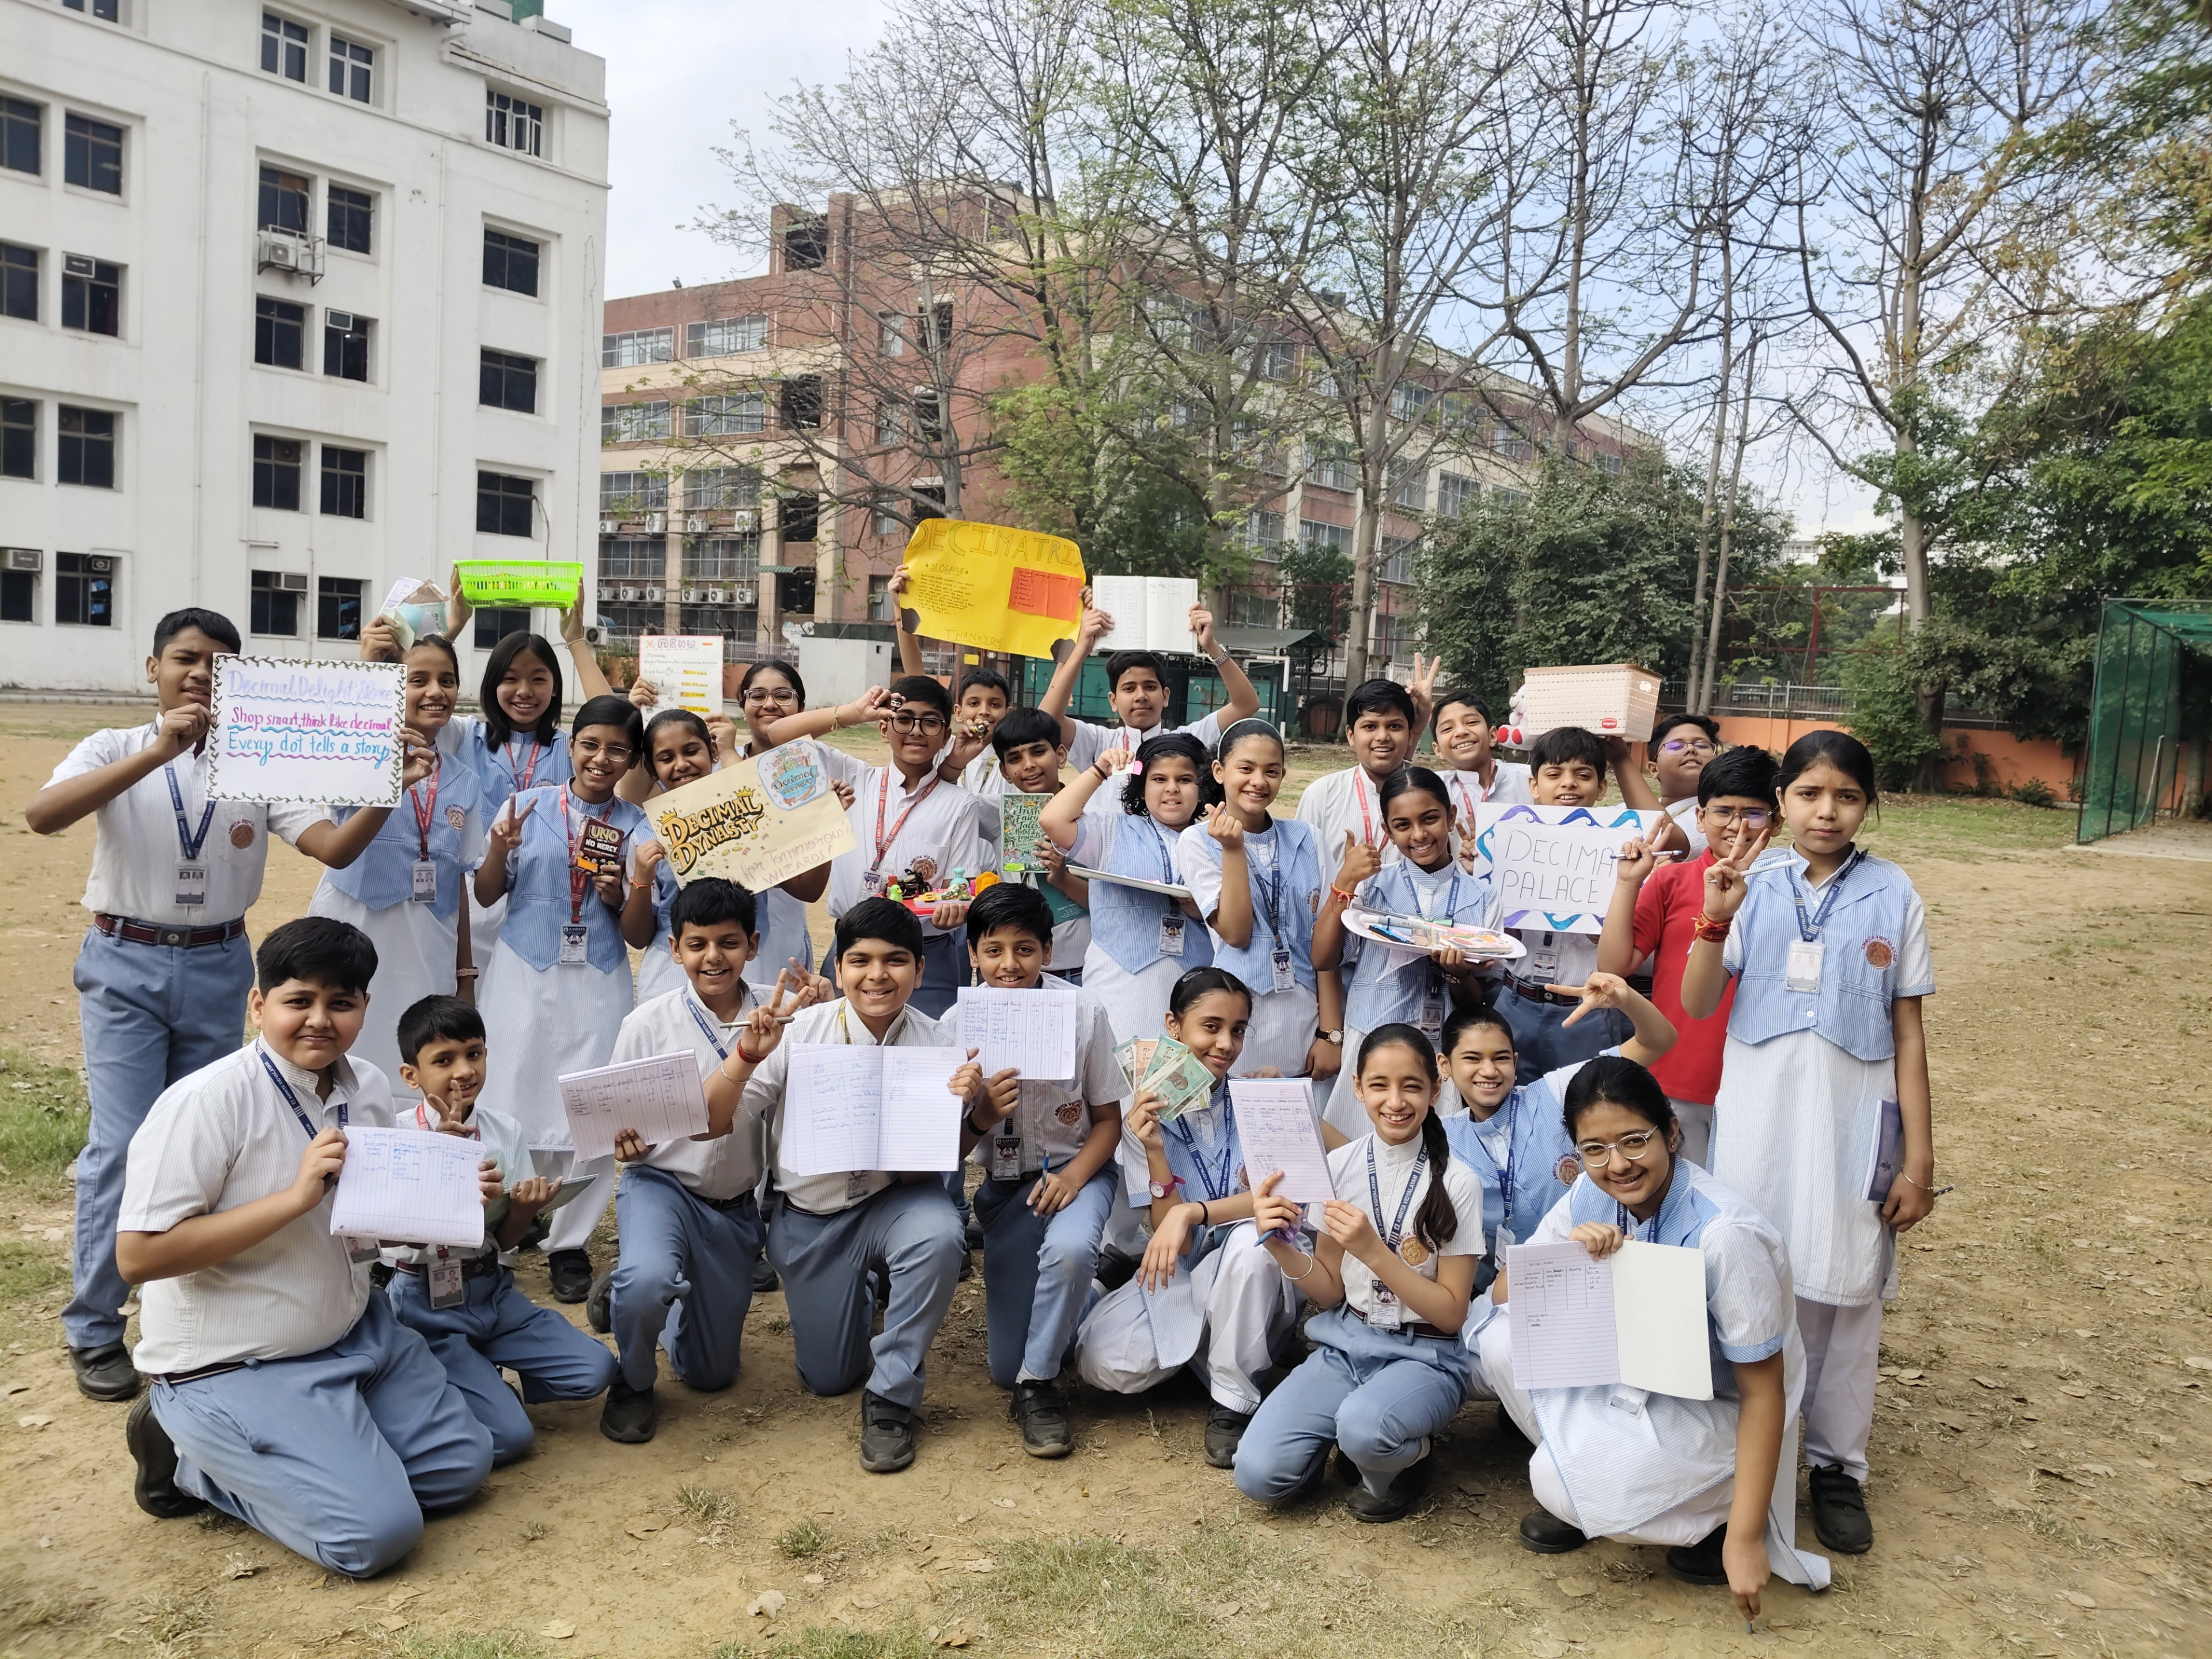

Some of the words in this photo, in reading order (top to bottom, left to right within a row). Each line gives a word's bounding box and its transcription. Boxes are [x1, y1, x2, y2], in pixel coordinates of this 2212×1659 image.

[931, 563, 964, 574] SLOGANS
[658, 638, 696, 648] MENU
[228, 669, 296, 695] Decimal
[298, 678, 356, 711] Delight
[356, 680, 393, 702] Store
[232, 707, 263, 731] Shop
[329, 713, 347, 729] like
[350, 713, 392, 731] decimal
[281, 732, 304, 753] dot
[310, 736, 335, 753] tells
[341, 743, 349, 753] a
[355, 738, 390, 769] story
[1015, 805, 1040, 815] Irish
[661, 796, 764, 850] DECIMAL
[1015, 815, 1039, 823] Fairy
[589, 825, 619, 843] UNO
[891, 821, 901, 834] AMRITA
[671, 812, 764, 876] DYNASTY
[1018, 832, 1040, 842] Legends
[585, 838, 595, 848] NO
[597, 843, 618, 853] MERCY
[1505, 830, 1614, 877] DECIMA
[910, 855, 923, 866] AMRITA
[923, 855, 938, 874] VIDYALAYAM
[1500, 870, 1599, 904] PALACE
[1825, 891, 1838, 906] AMRITA
[1861, 935, 1874, 950] AMRITA
[690, 1004, 704, 1027] VIDYALAYAM
[703, 1023, 712, 1037] AMRITA
[264, 1061, 283, 1085] VIDYALAYAM
[282, 1084, 292, 1100] AMRITA
[1055, 1103, 1067, 1116] AMRITA
[1180, 1124, 1189, 1138] AMRITA
[1195, 1158, 1209, 1180] VIDYALAYAM
[1234, 1162, 1243, 1179] AMRITA
[1204, 1179, 1213, 1195] AMRITA
[1370, 1176, 1378, 1211] VIDYALAYAM
[1396, 1203, 1407, 1223] AMRITA
[1402, 1175, 1417, 1205] VIDYALAYAM
[1397, 1232, 1412, 1247] AMRITA
